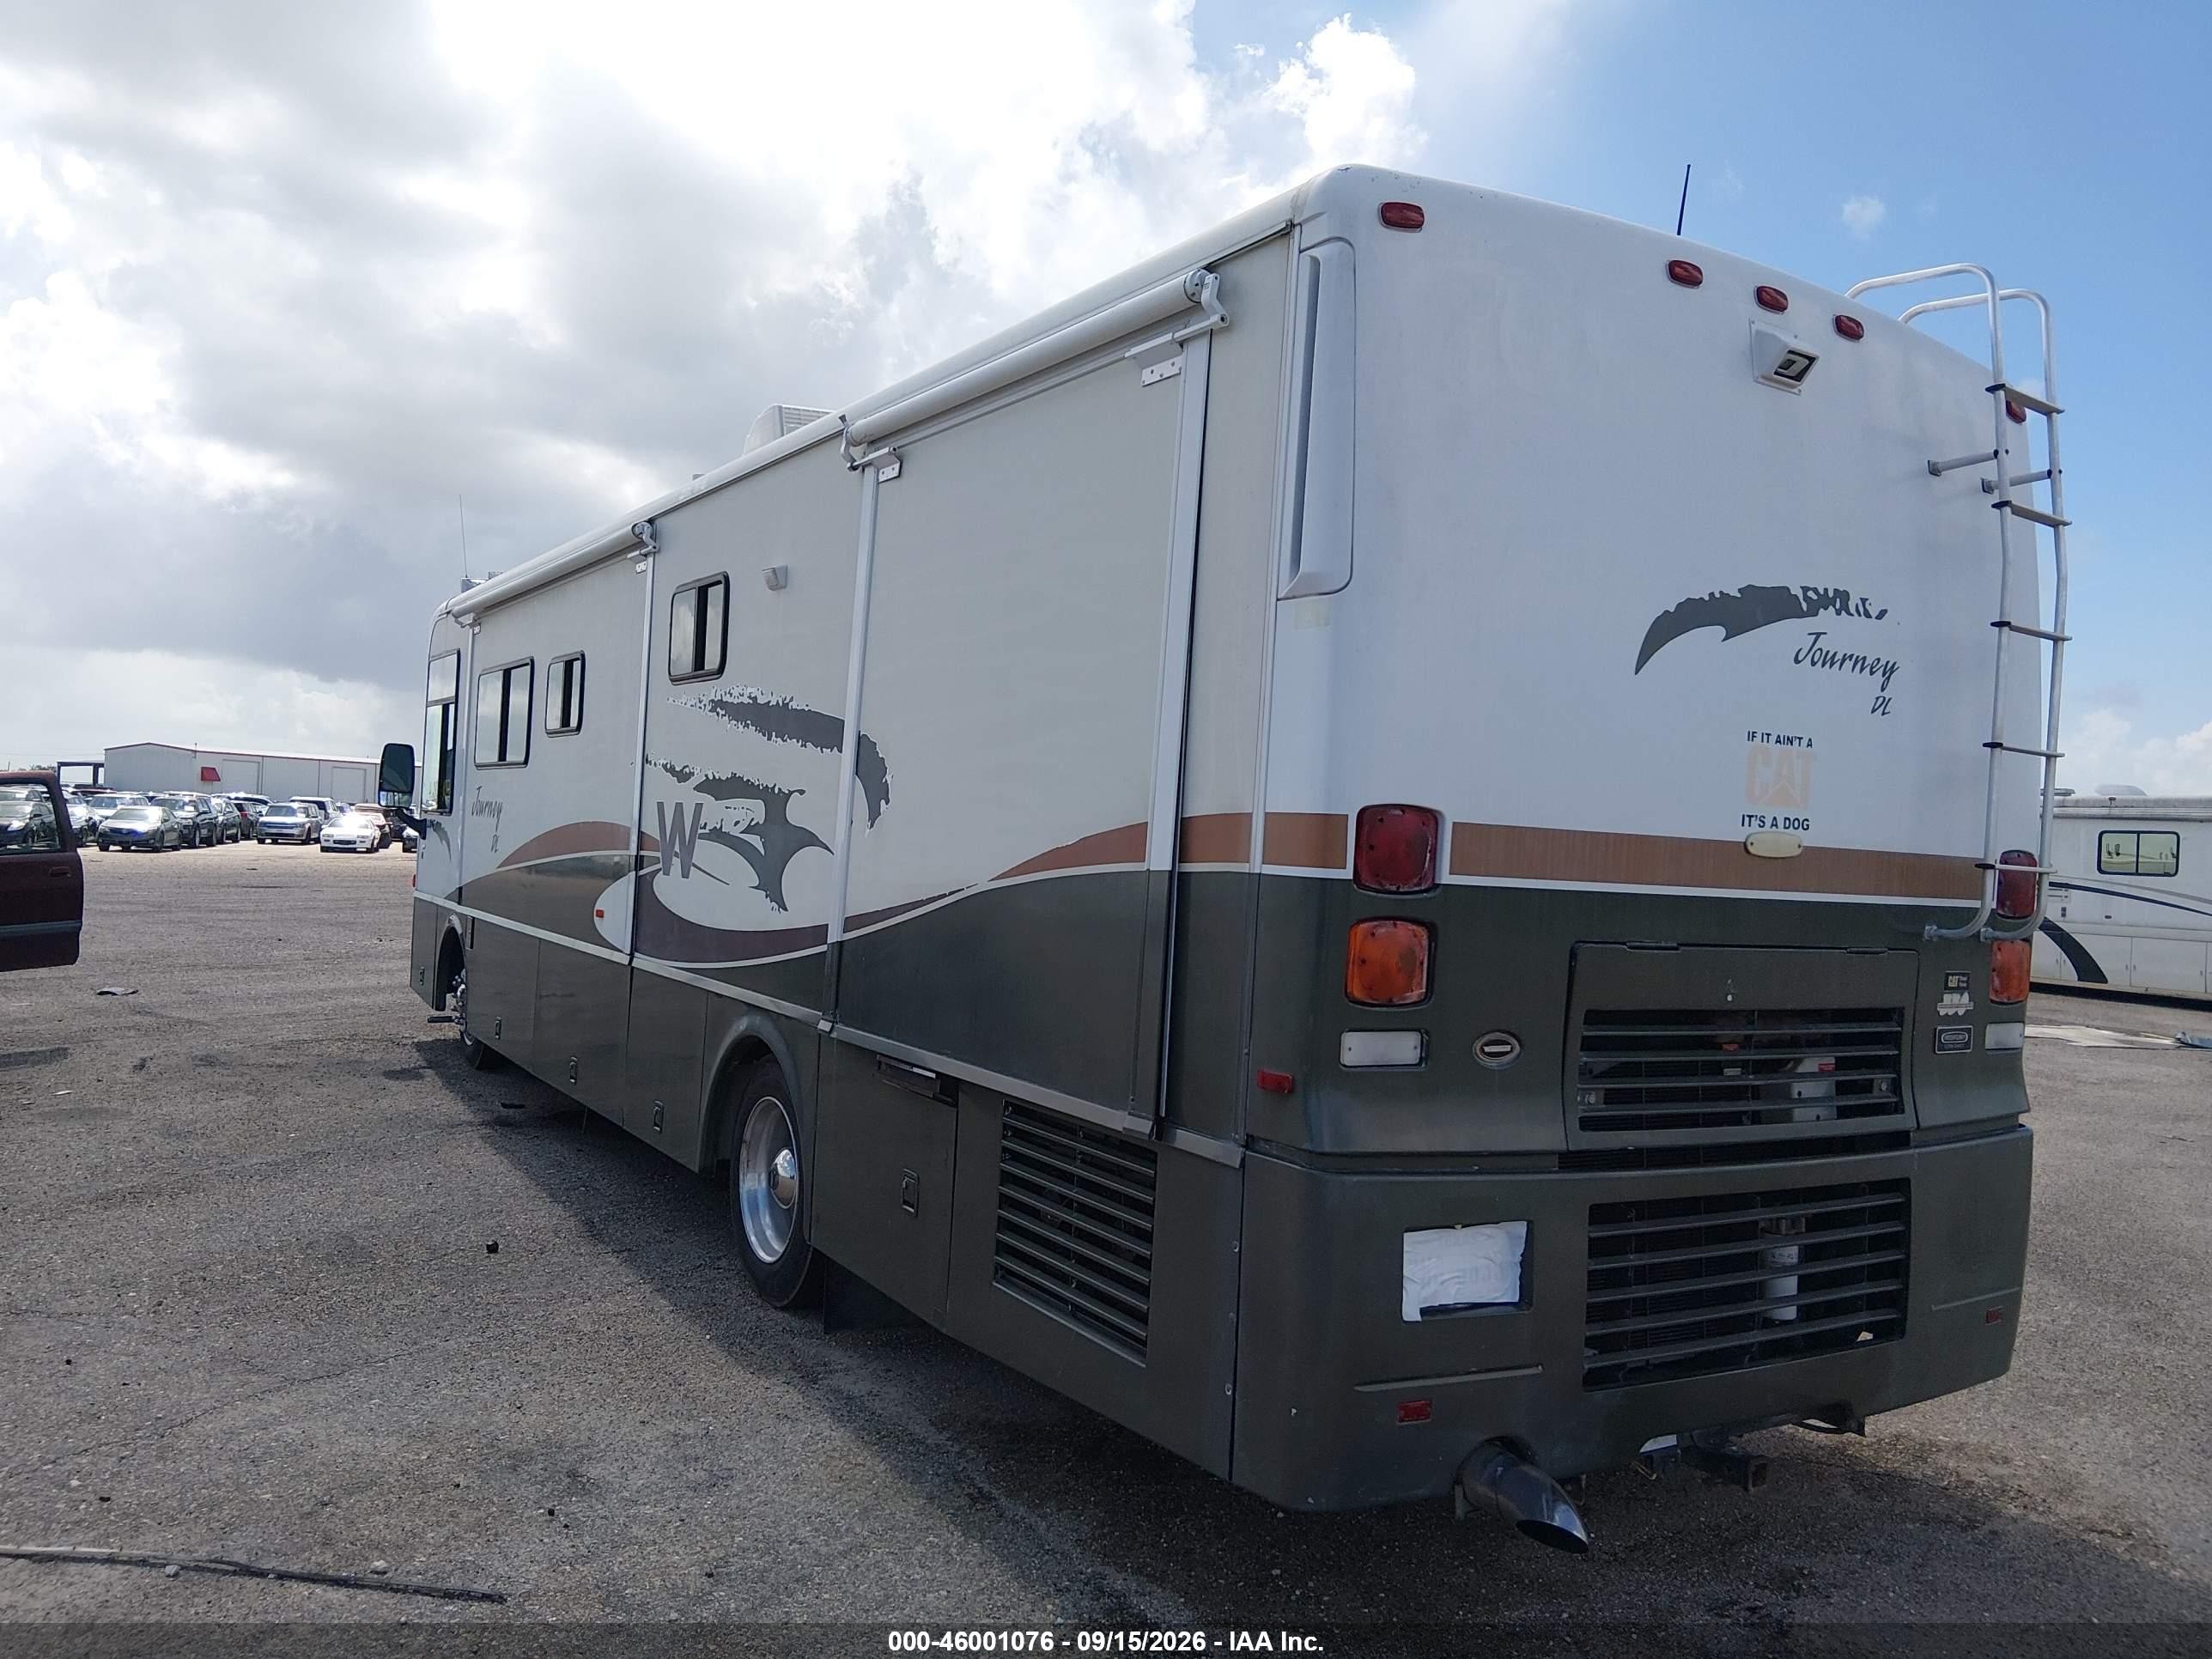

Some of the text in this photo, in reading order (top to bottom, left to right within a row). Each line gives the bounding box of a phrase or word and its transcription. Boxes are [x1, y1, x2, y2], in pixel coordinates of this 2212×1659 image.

[1794, 631, 1900, 693] Journey
[1870, 696, 1893, 716] DL
[1747, 730, 1814, 749] IF IT AIN'T A
[1745, 744, 1814, 811] CAT
[471, 785, 503, 833] Journey
[1741, 814, 1810, 831] IT'S A DOG
[656, 801, 704, 879] W
